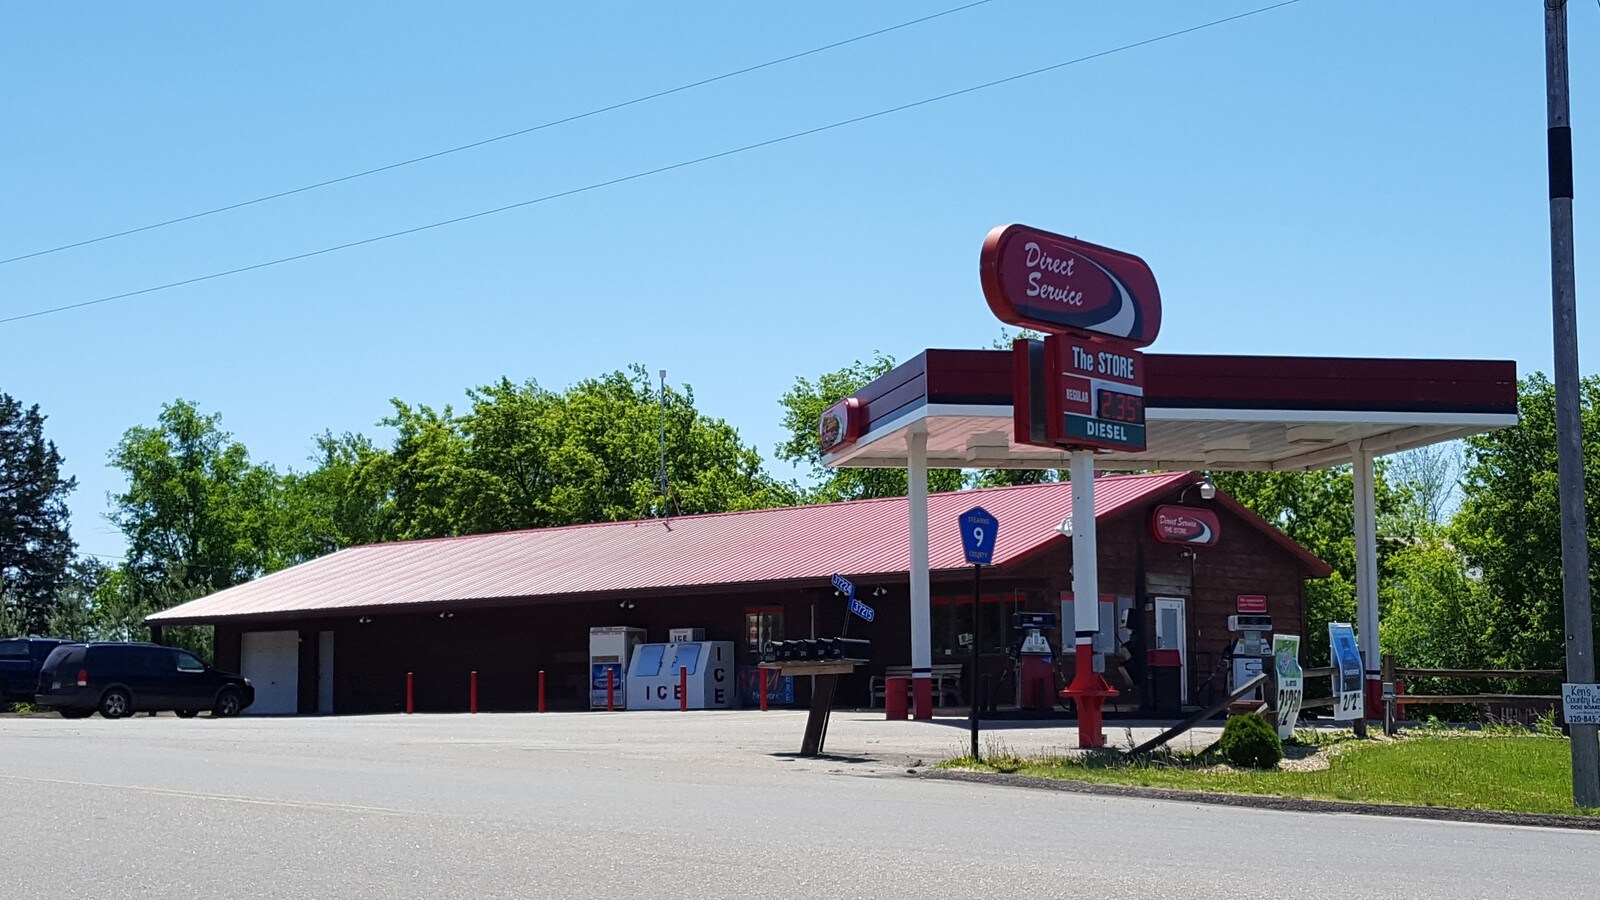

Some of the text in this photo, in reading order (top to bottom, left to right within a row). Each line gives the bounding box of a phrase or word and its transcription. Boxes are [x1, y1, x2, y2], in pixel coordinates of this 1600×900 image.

[1025, 242, 1074, 276] Direct
[1026, 271, 1083, 306] Service
[1072, 346, 1134, 379] The STORE
[1066, 388, 1089, 403] REGULAR
[1086, 421, 1127, 440] DIESEL
[973, 527, 984, 547] 9
[853, 602, 873, 620] 37215
[714, 646, 725, 704] ICE
[646, 684, 682, 700] ICE
[1565, 695, 1590, 706] Country
[1571, 686, 1591, 696] Ken's
